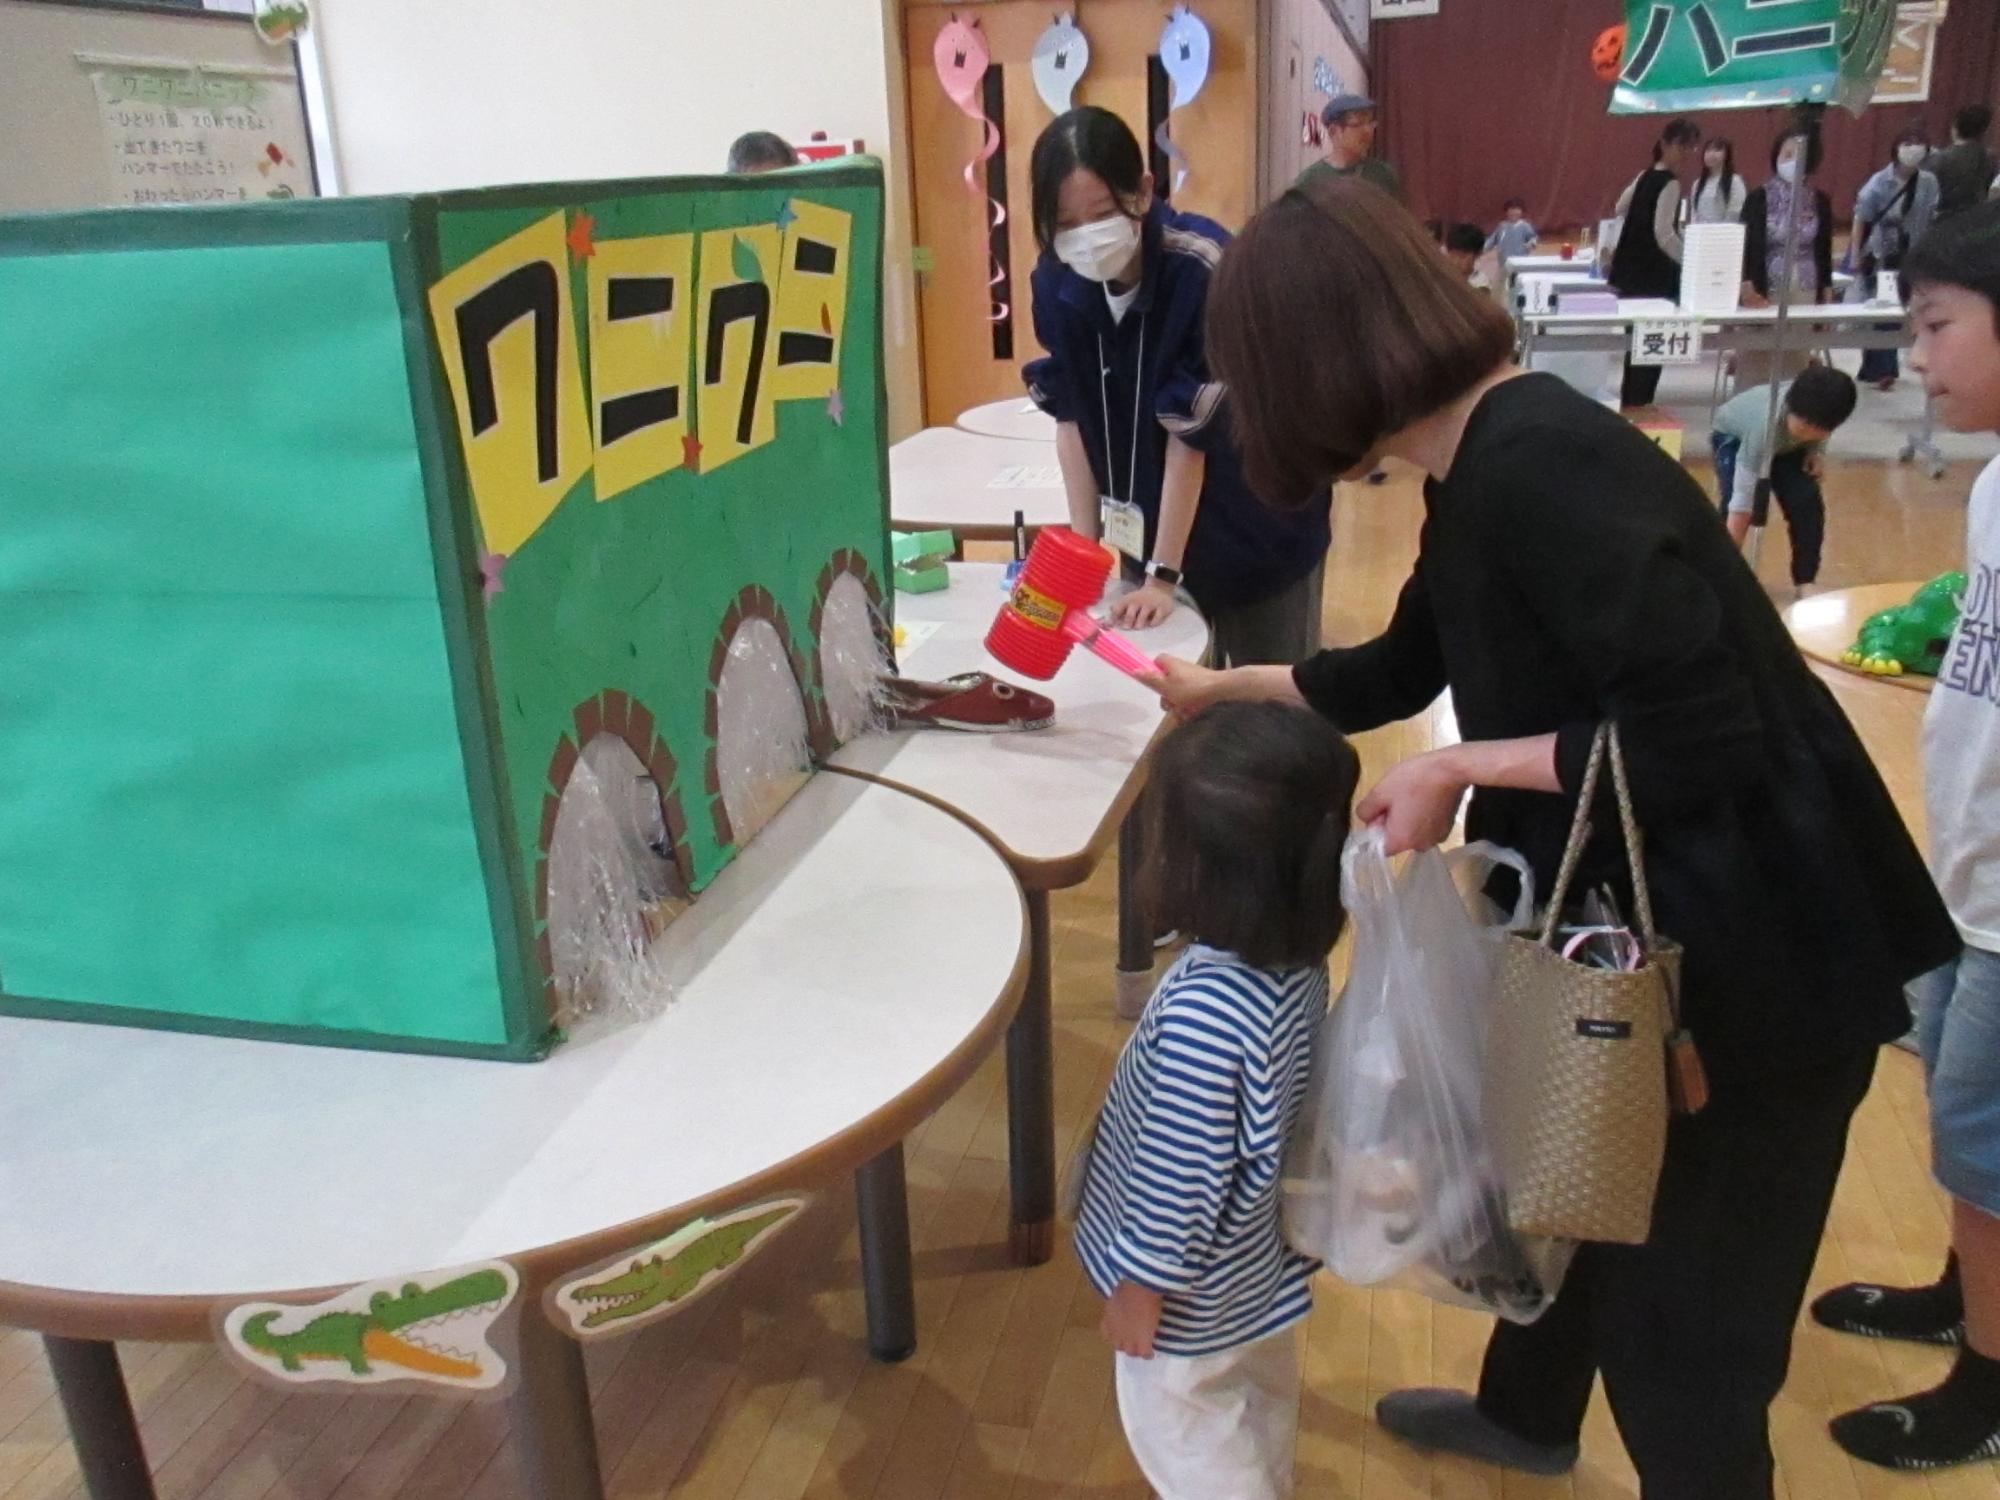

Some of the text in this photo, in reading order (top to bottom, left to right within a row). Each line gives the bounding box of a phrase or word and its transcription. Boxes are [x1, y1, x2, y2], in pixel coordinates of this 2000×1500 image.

[455, 236, 837, 484] ワニワニ
[1643, 331, 1691, 356] 受付
